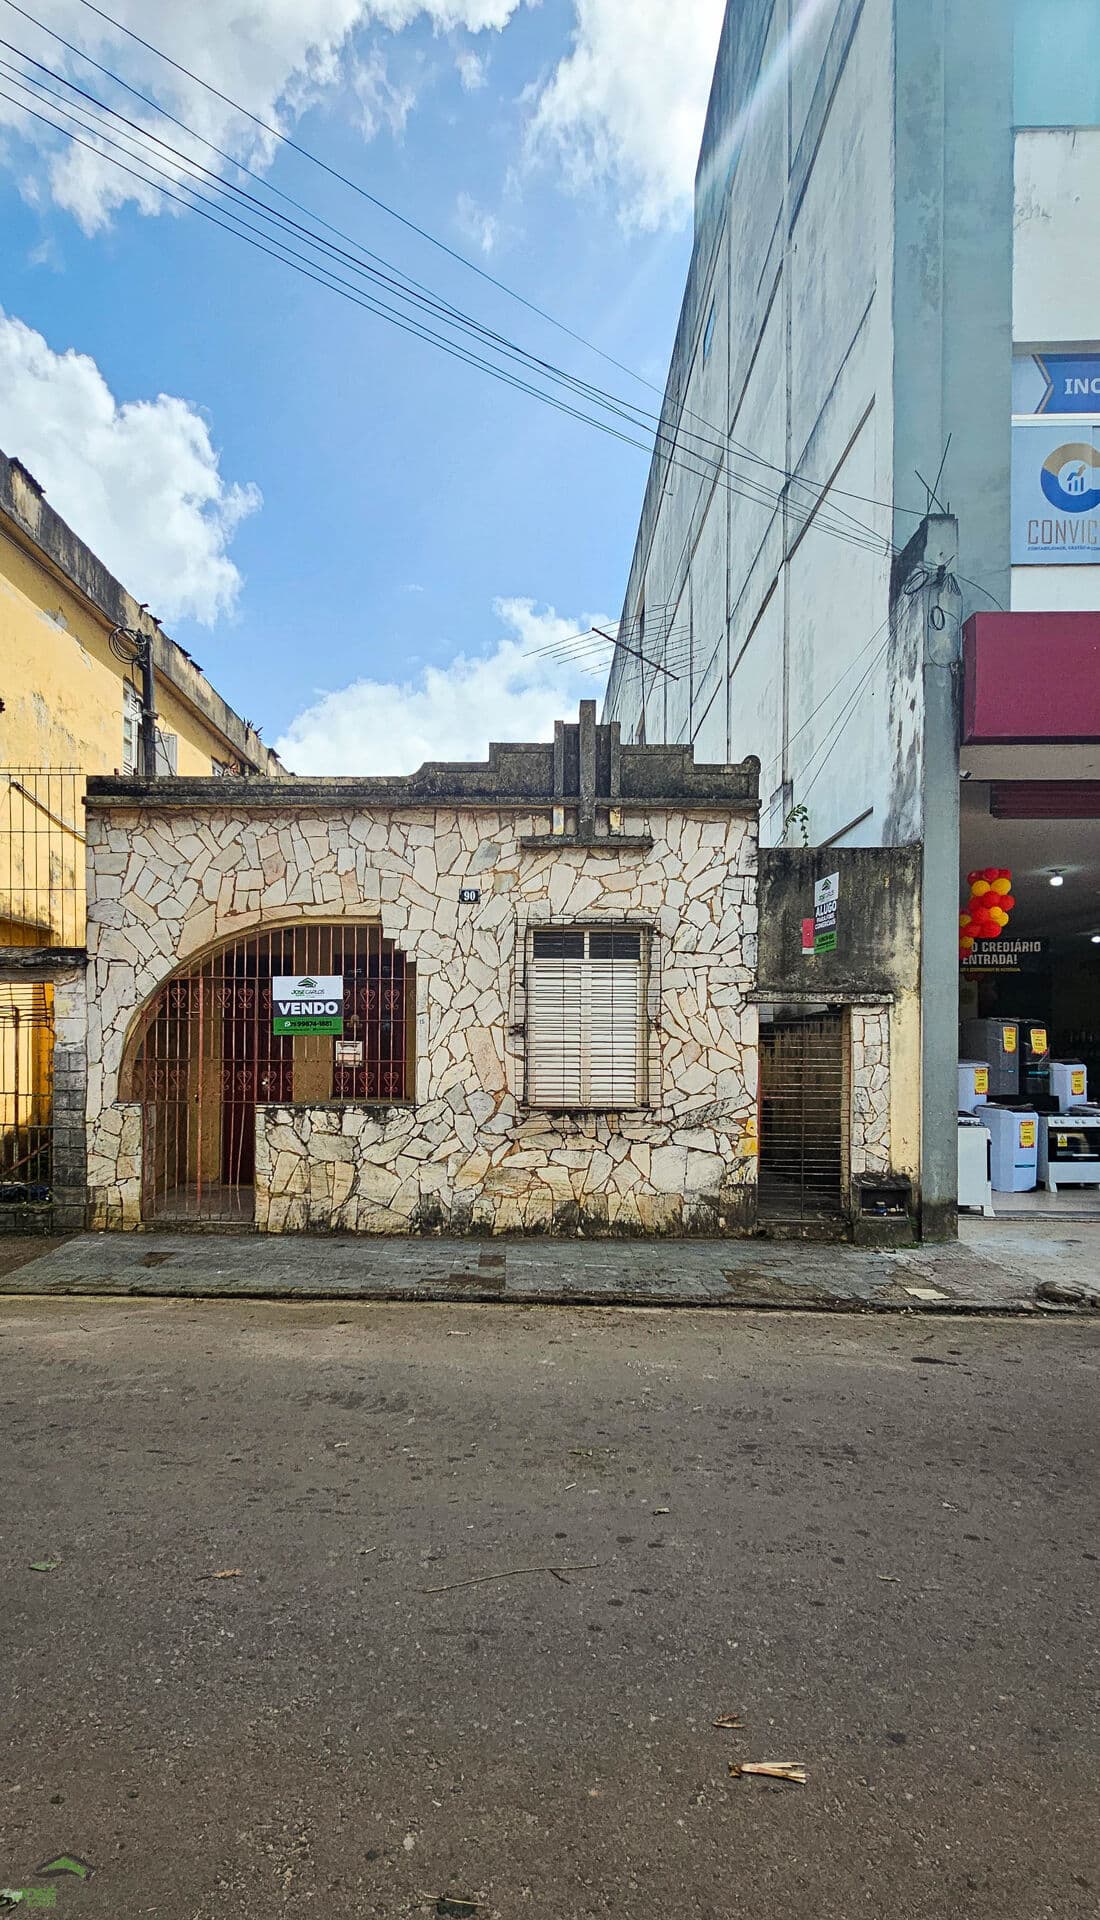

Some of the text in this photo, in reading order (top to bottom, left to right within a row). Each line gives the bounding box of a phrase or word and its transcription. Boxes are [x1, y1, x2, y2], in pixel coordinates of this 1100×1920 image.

[464, 890, 476, 901] 90
[815, 901, 836, 917] ALUGO
[982, 938, 1041, 952] CREDIÁRIO
[278, 1002, 338, 1015] VENDO
